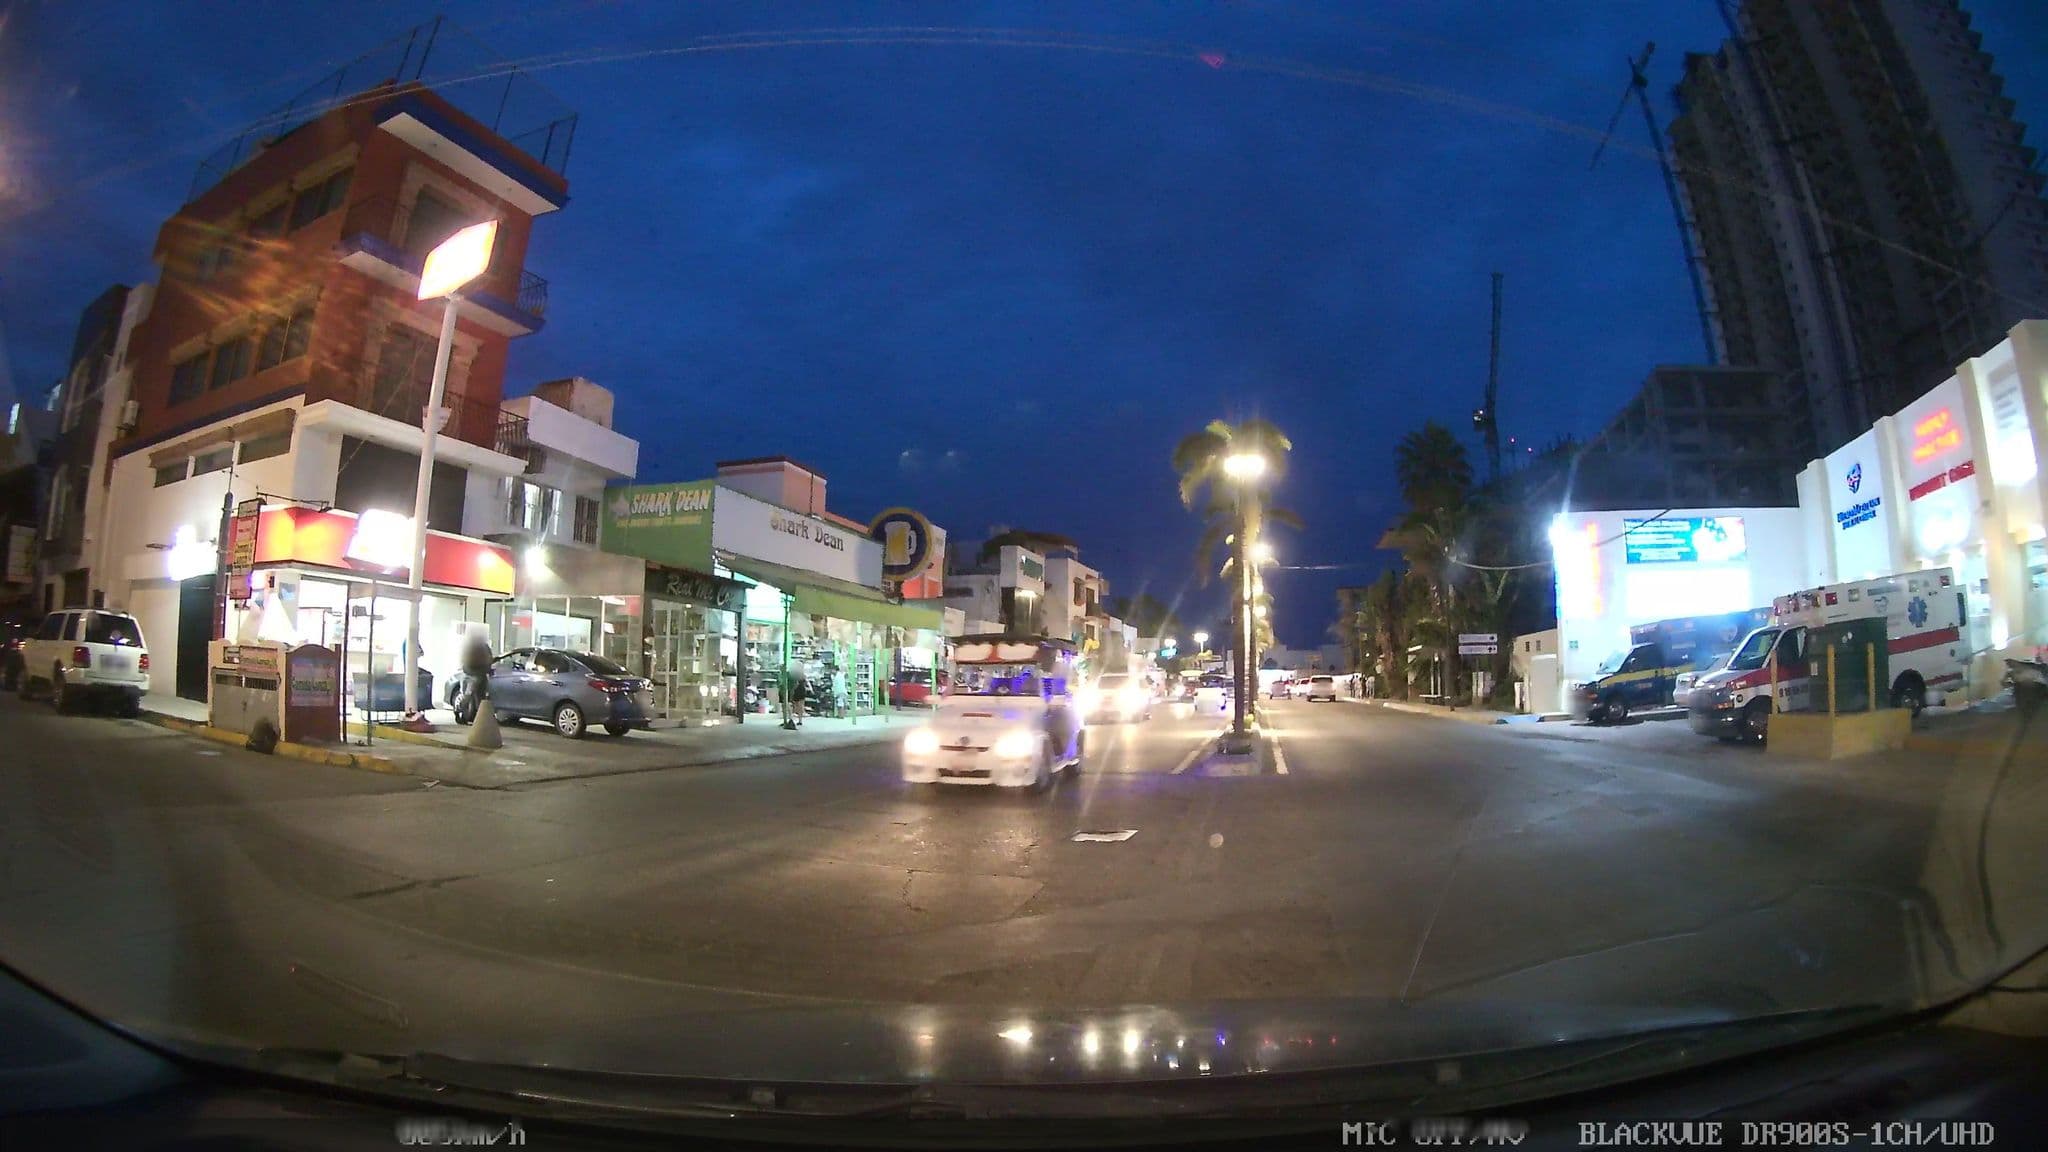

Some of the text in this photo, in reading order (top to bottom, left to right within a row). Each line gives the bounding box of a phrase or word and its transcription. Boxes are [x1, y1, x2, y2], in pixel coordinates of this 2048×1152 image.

[631, 489, 712, 517] SHARK DEAN
[814, 525, 844, 551] Dean
